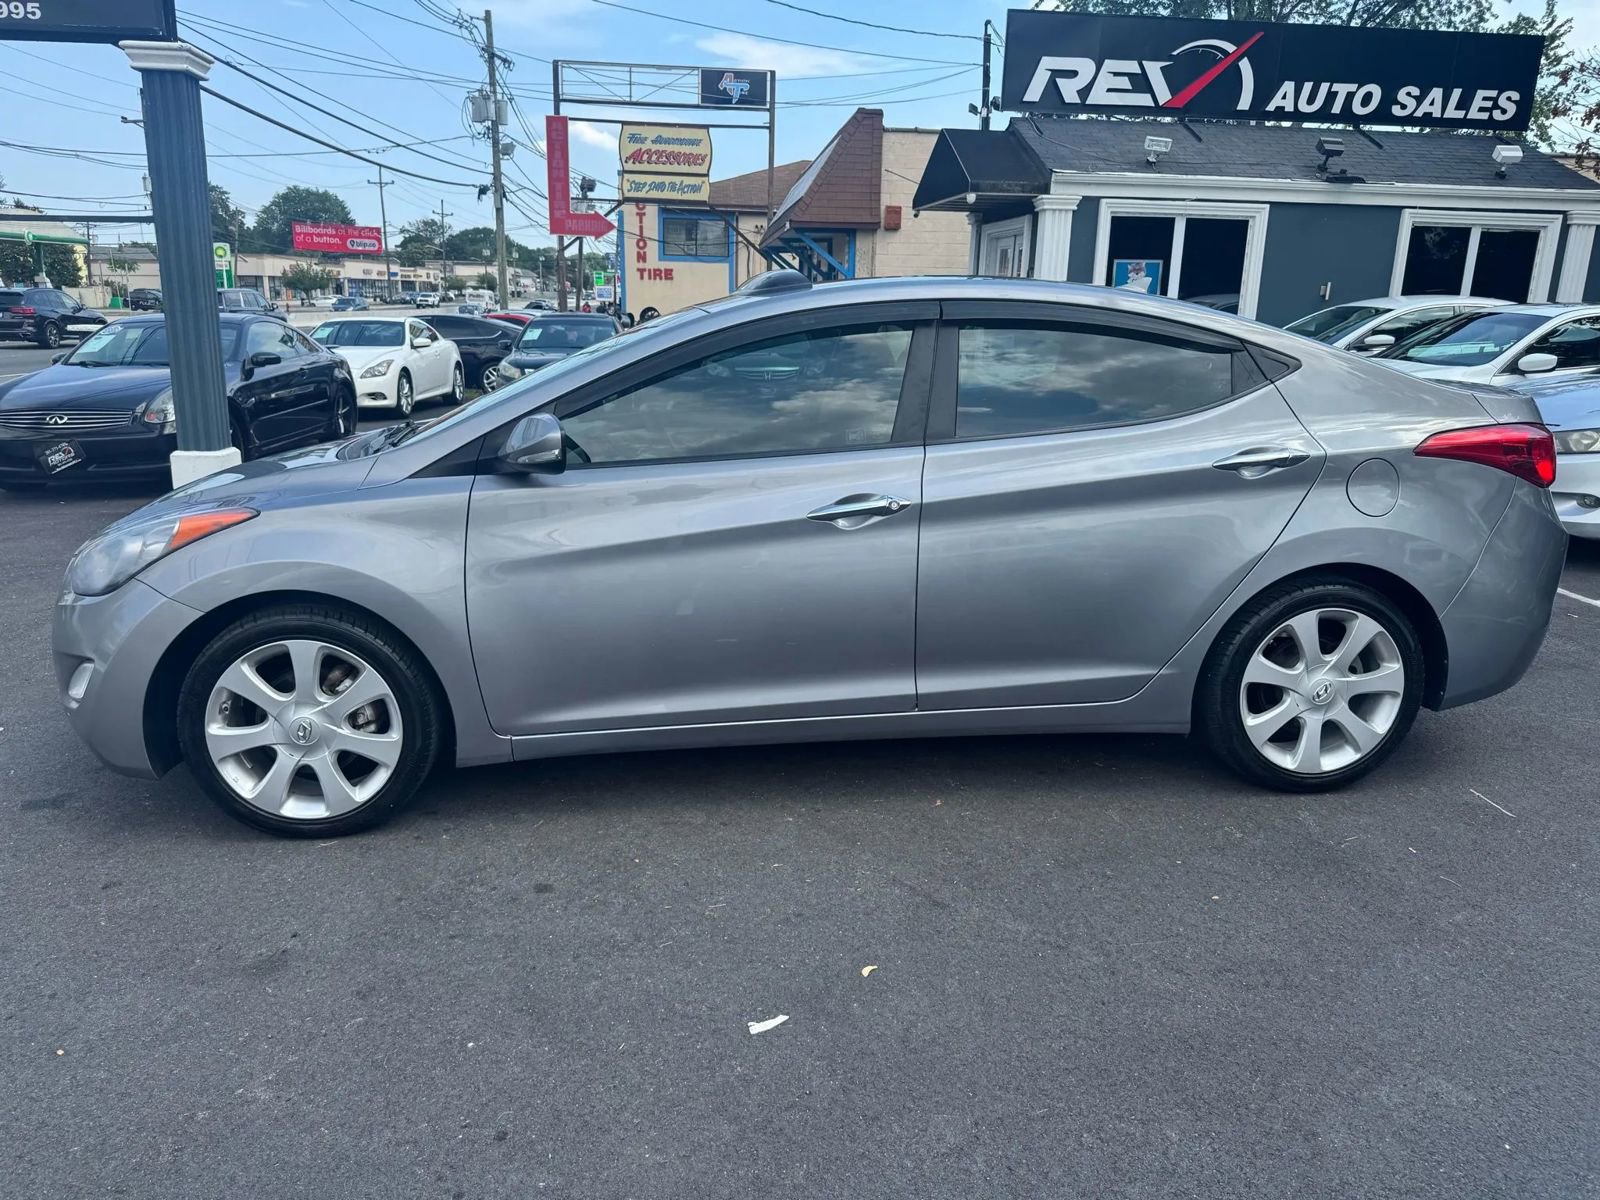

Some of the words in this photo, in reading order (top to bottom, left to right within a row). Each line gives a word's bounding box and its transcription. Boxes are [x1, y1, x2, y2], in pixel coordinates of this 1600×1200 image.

[1265, 81, 1382, 115] AUTO
[1392, 86, 1521, 121] SALES
[624, 148, 708, 167] ACCESSORIES
[295, 225, 336, 235] Billboards
[313, 235, 342, 244] button.
[636, 268, 674, 281] TIRE
